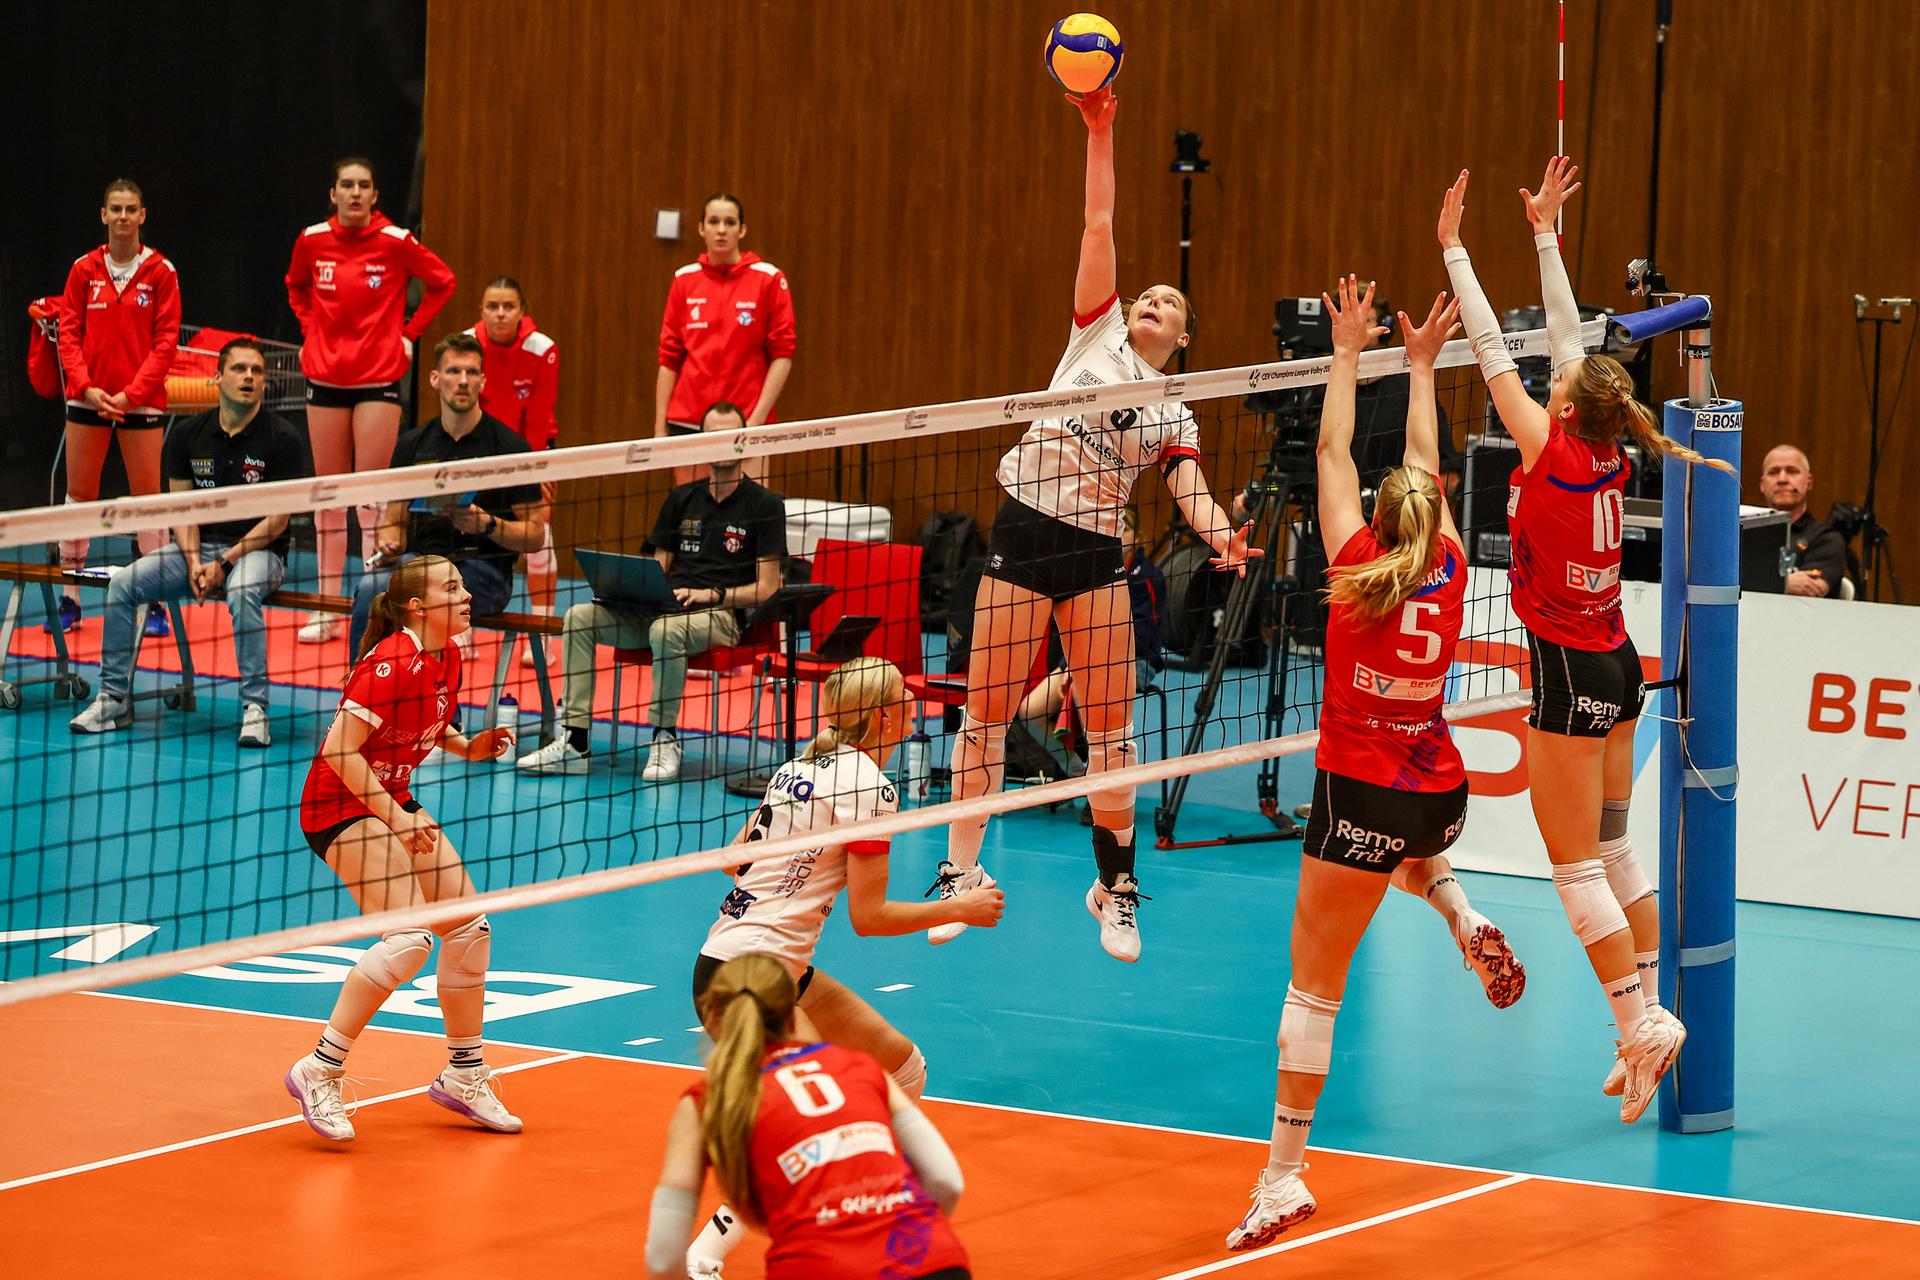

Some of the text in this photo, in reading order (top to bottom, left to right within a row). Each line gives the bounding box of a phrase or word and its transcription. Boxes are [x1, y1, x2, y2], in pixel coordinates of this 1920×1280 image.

[1305, 302, 1313, 311] 2
[1508, 338, 1526, 351] CEV
[1262, 372, 1271, 381] CEV
[1271, 370, 1294, 380] Champions
[1295, 369, 1309, 377] League
[1310, 366, 1323, 375] Volley
[1054, 398, 1071, 407] League
[1071, 395, 1085, 405] Volley
[1712, 413, 1743, 429] BOSA
[1592, 488, 1624, 552] 10
[1568, 564, 1602, 591] BV
[1396, 600, 1442, 664] 5
[1355, 665, 1396, 695] BV
[1808, 672, 1920, 740] BE
[1336, 819, 1406, 852] Remo
[1343, 842, 1386, 863] Frit
[774, 1059, 846, 1118] 6
[783, 1138, 821, 1178] BV
